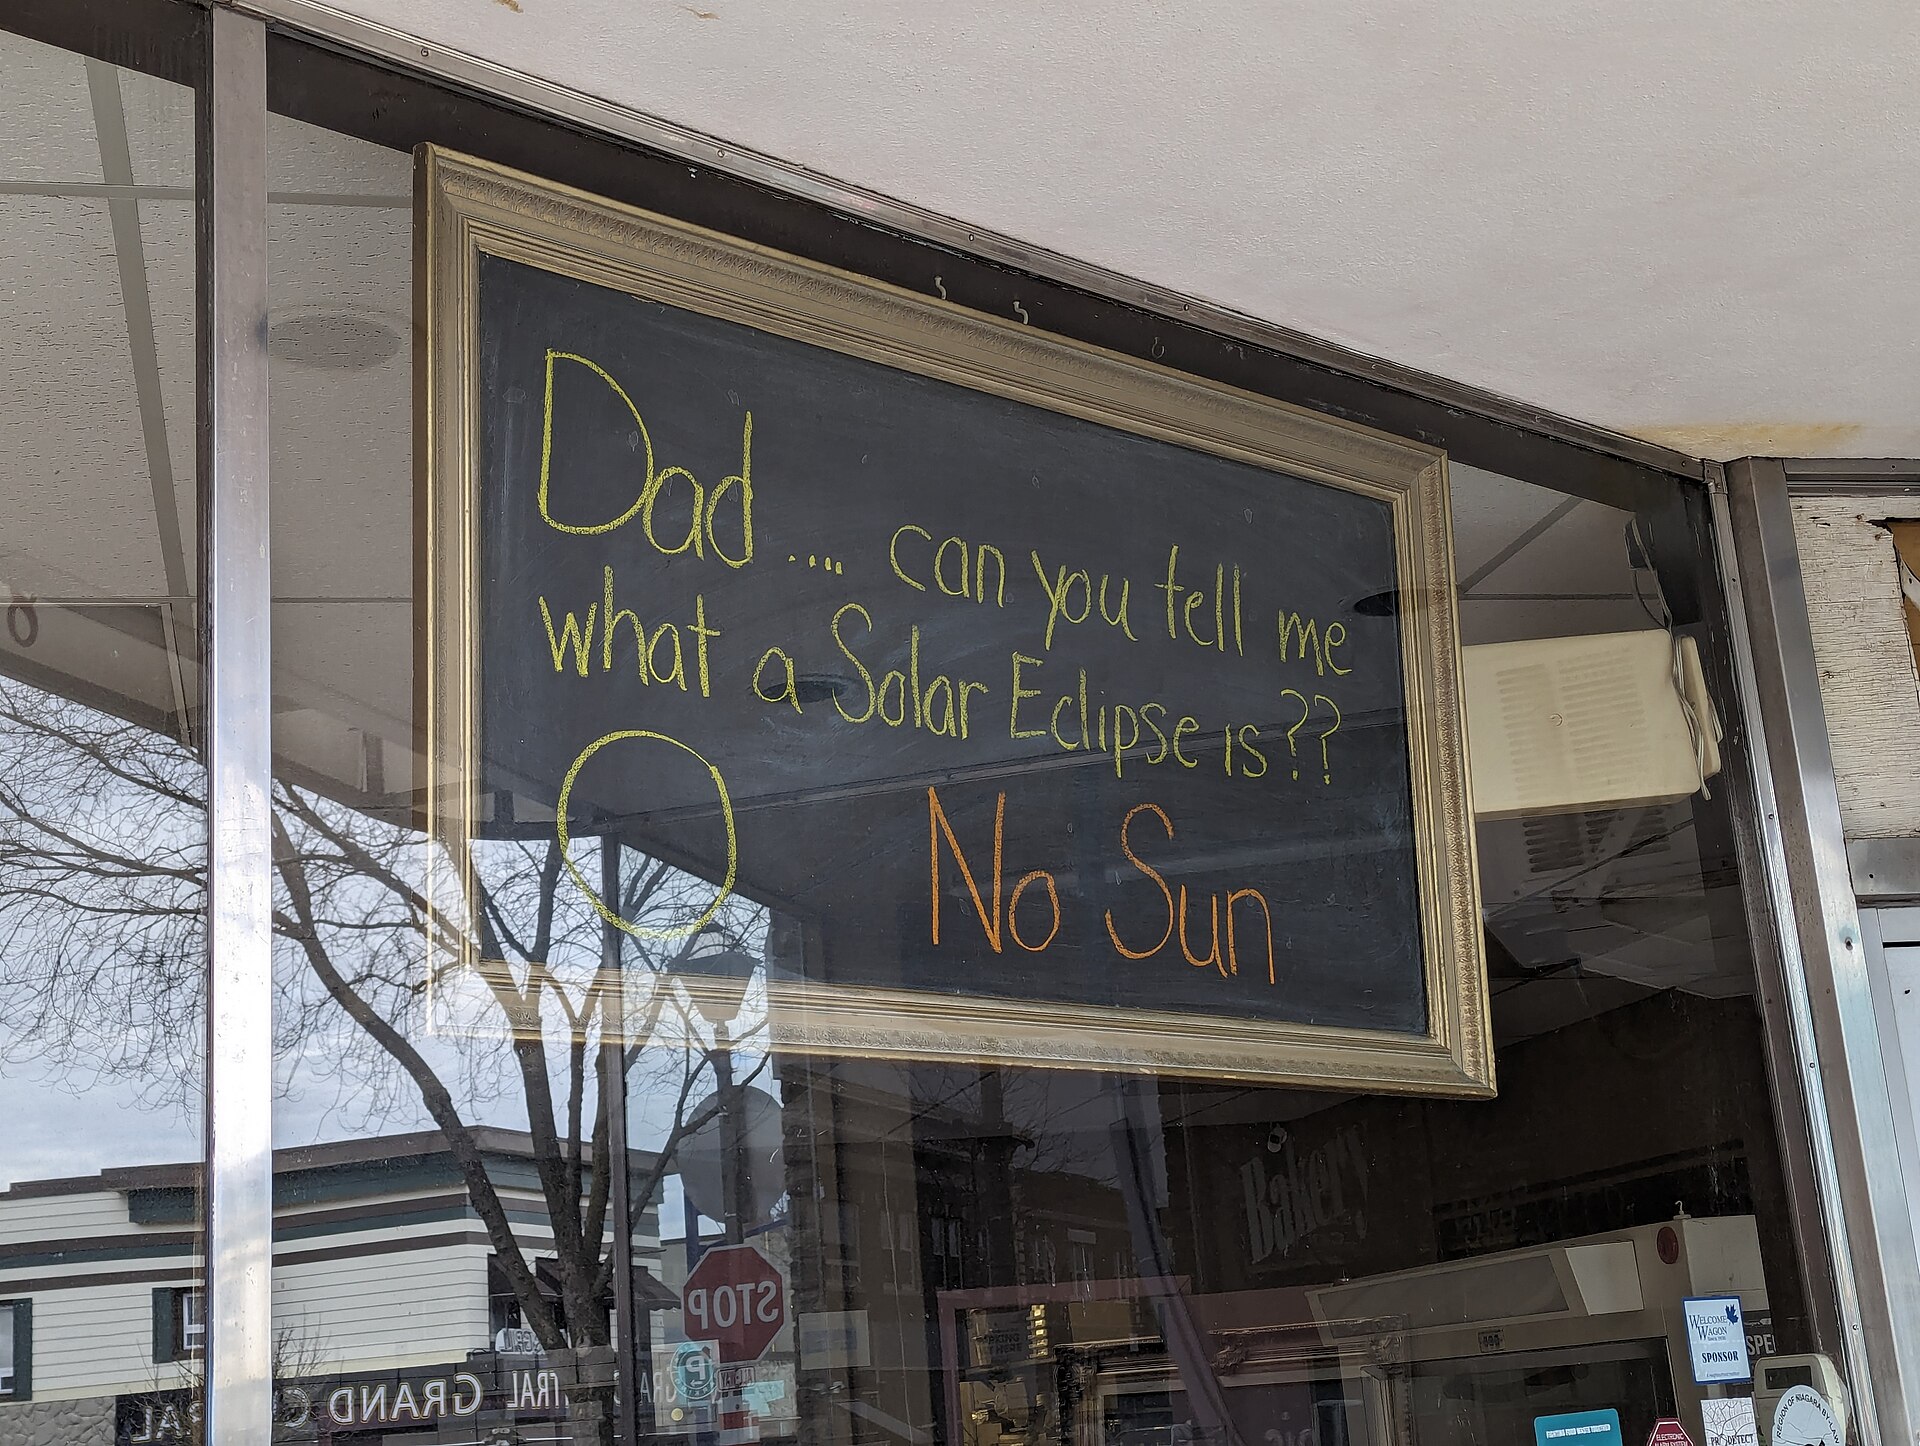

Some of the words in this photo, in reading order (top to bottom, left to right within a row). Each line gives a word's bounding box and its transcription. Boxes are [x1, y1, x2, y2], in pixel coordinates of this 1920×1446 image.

[538, 348, 755, 569] Dad
[889, 523, 1005, 609] can
[1031, 549, 1139, 652] you
[1154, 543, 1244, 657] tell
[1277, 608, 1354, 677] me
[538, 565, 721, 698] what
[752, 646, 803, 714] a
[831, 602, 989, 741] Solar
[1010, 650, 1201, 780] Eclipse
[926, 785, 1062, 955] No
[1104, 802, 1277, 986] Sun
[1688, 1313, 1728, 1330] WELCOME
[1697, 1326, 1728, 1341] WAGON
[1701, 1350, 1739, 1364] SPONSOR
[1776, 1404, 1789, 1439] REGION
[1787, 1396, 1795, 1407] OF
[1795, 1393, 1822, 1412] NIAGARA
